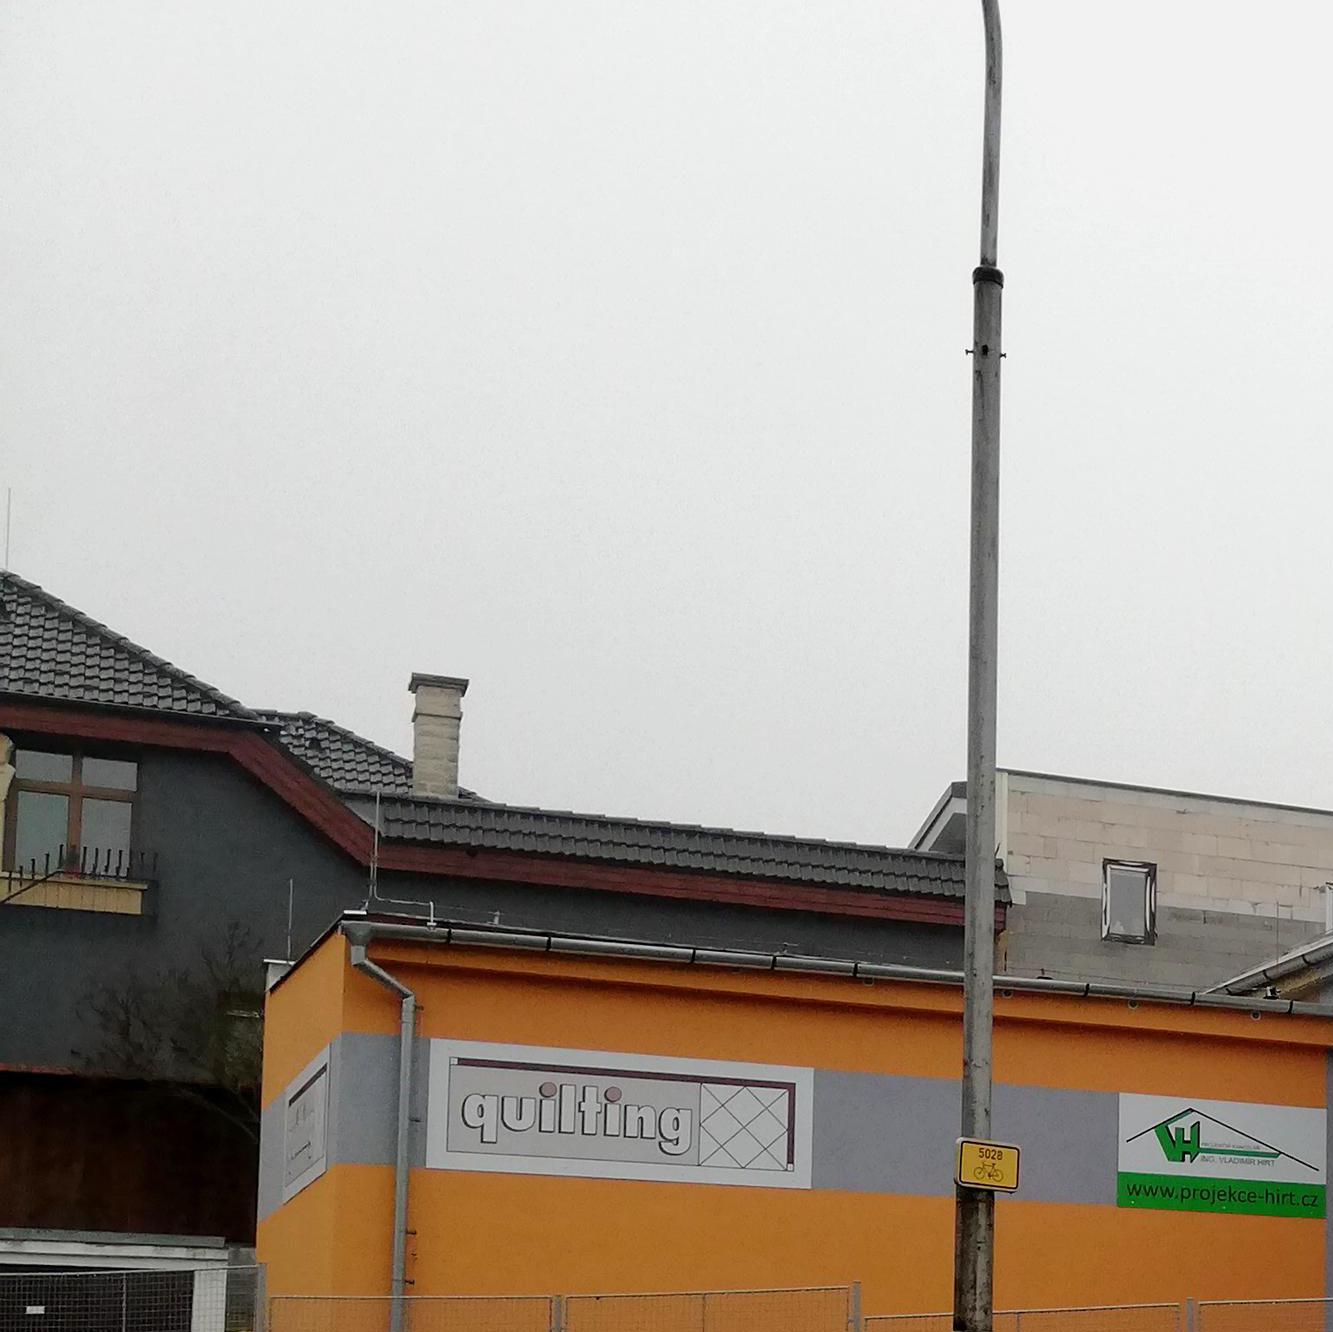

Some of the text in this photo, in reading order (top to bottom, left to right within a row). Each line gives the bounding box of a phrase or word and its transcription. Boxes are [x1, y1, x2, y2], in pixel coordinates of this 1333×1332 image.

[461, 1081, 693, 1156] quilting
[978, 1147, 1004, 1161] 5028
[1127, 1181, 1319, 1208] www.projekce-hirt.cz
